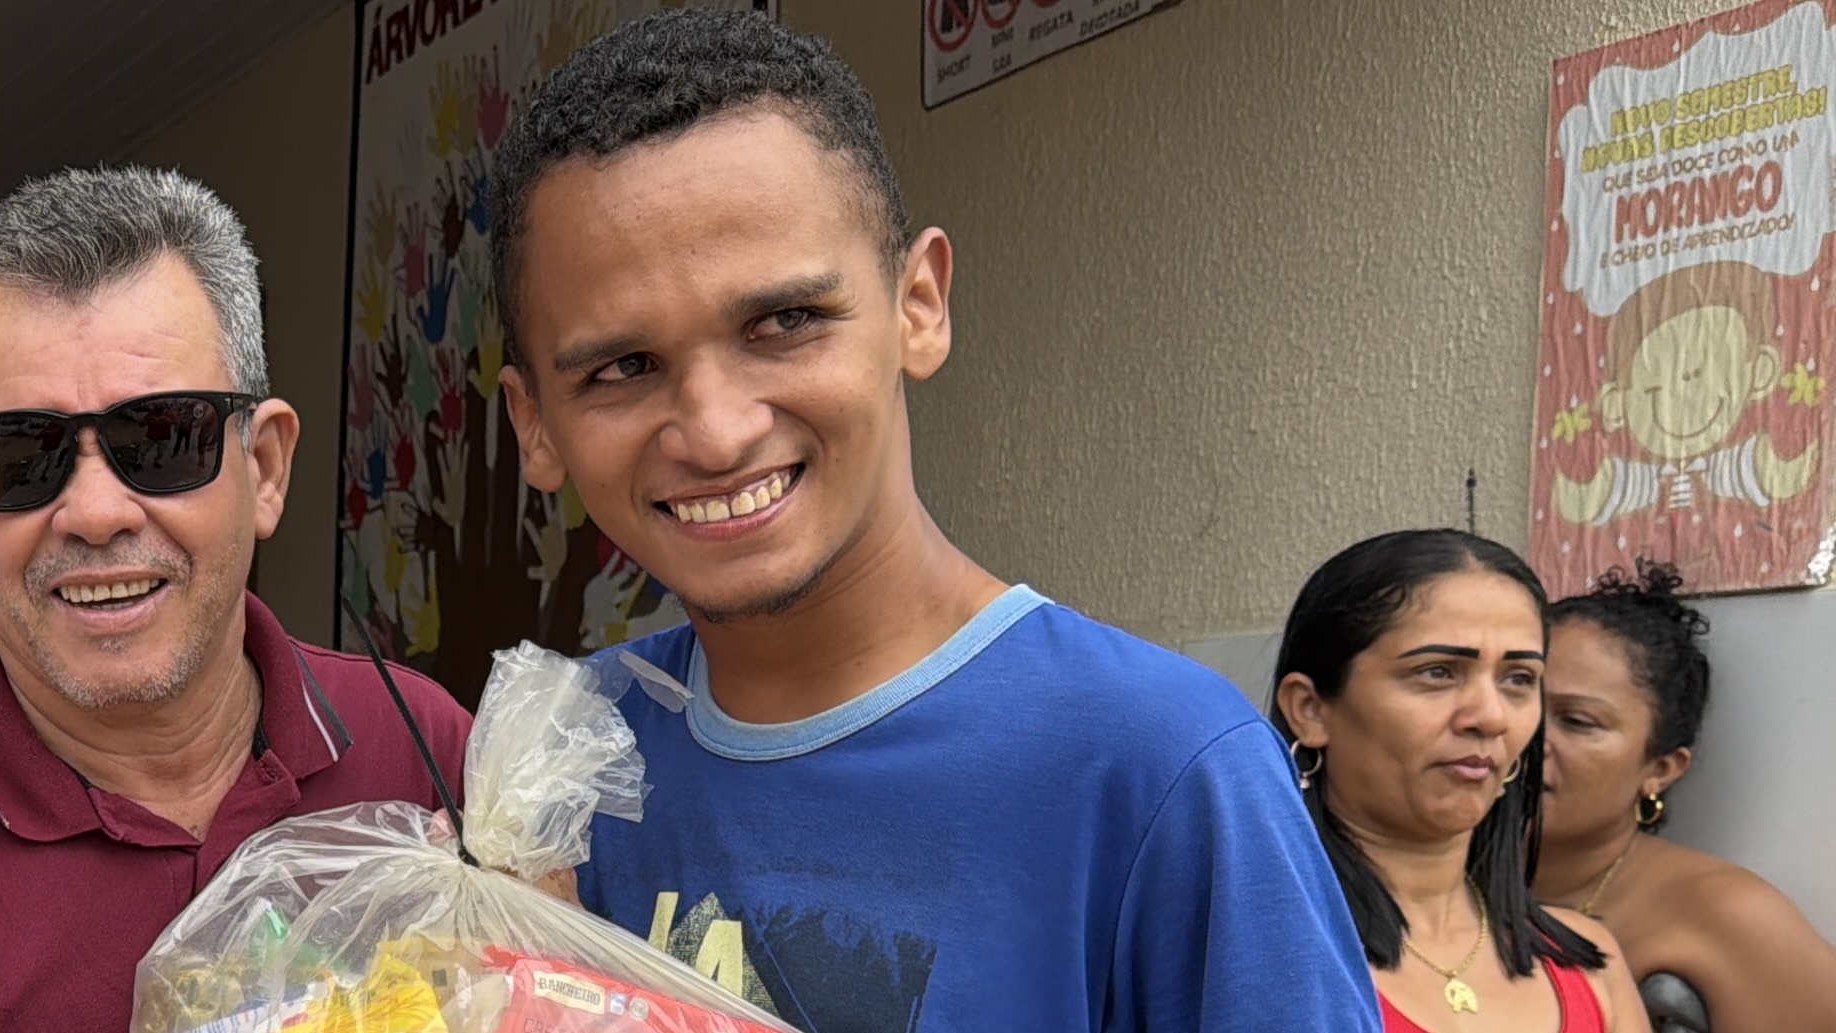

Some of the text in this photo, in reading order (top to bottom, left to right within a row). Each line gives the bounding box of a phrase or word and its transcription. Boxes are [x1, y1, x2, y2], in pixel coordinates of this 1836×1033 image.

[938, 57, 971, 84] SHORT
[1582, 87, 1828, 173] NOVAS DESCOBERTAS!
[1612, 100, 1670, 136] NOVO
[1604, 132, 1800, 192] QUE SEJA DOCE COMO UM
[1616, 161, 1782, 244] MORANGO
[1612, 243, 1656, 267] CHEIO
[1662, 239, 1678, 256] DE
[537, 976, 602, 1007] RANCHEIRO
